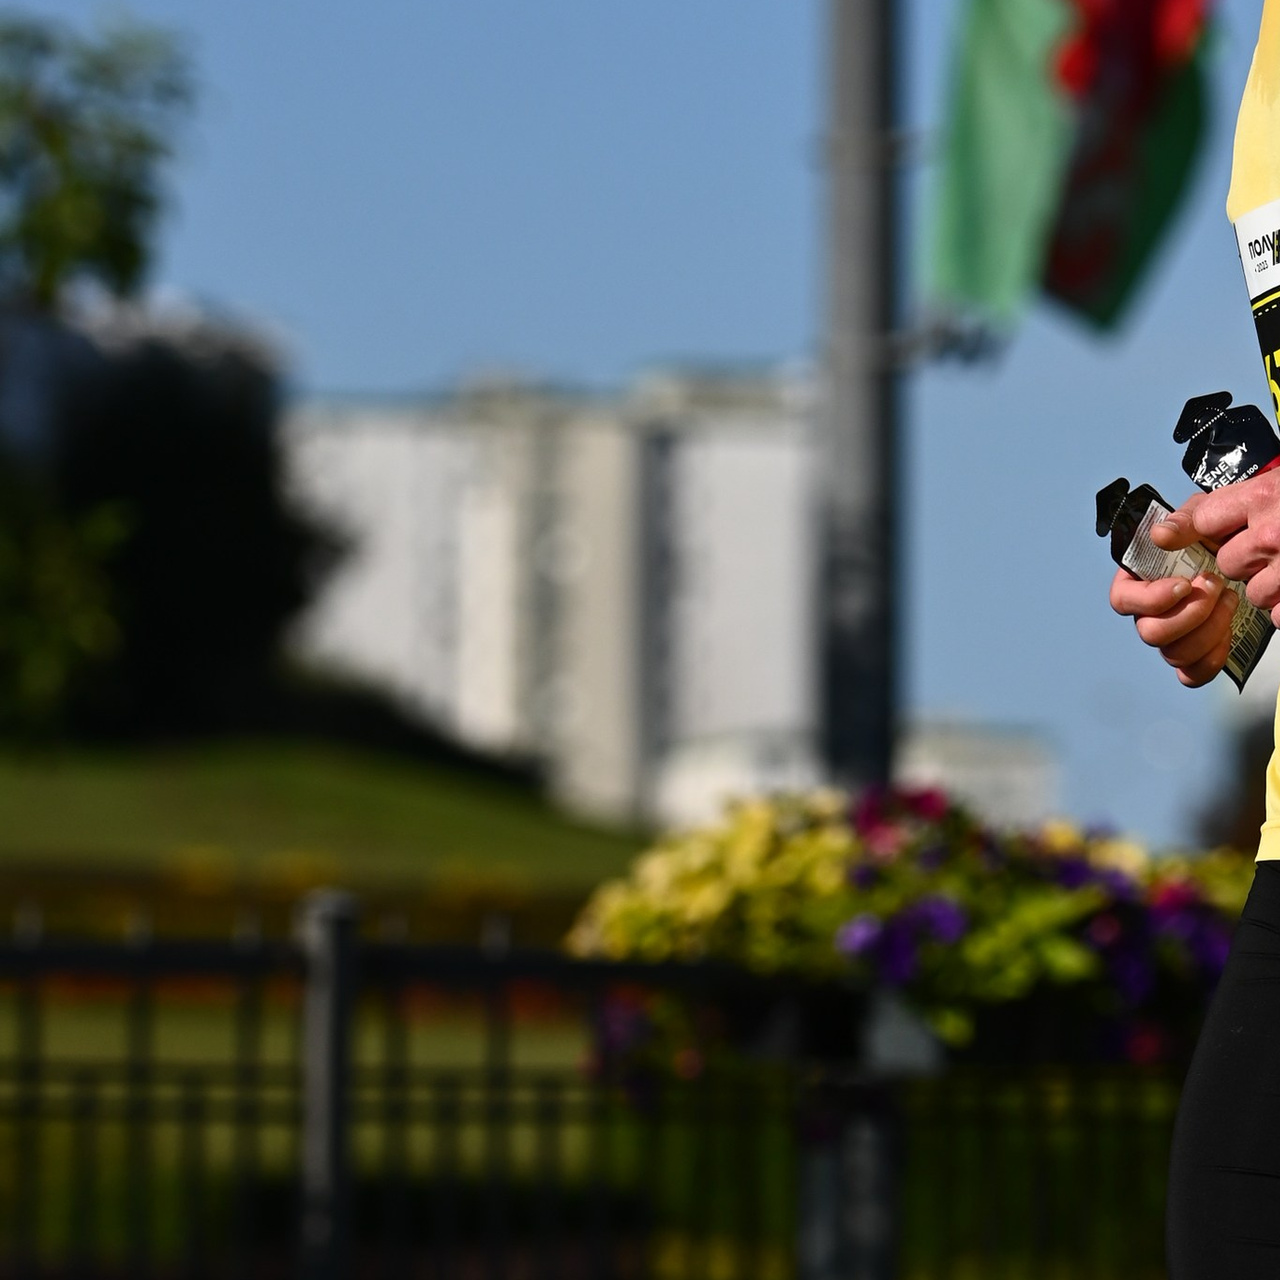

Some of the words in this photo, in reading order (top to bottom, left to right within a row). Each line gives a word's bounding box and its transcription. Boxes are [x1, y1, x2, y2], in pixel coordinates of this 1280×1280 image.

[1256, 260, 1269, 273] 2023
[1203, 441, 1248, 484] ENEY
[1247, 463, 1259, 478] 100
